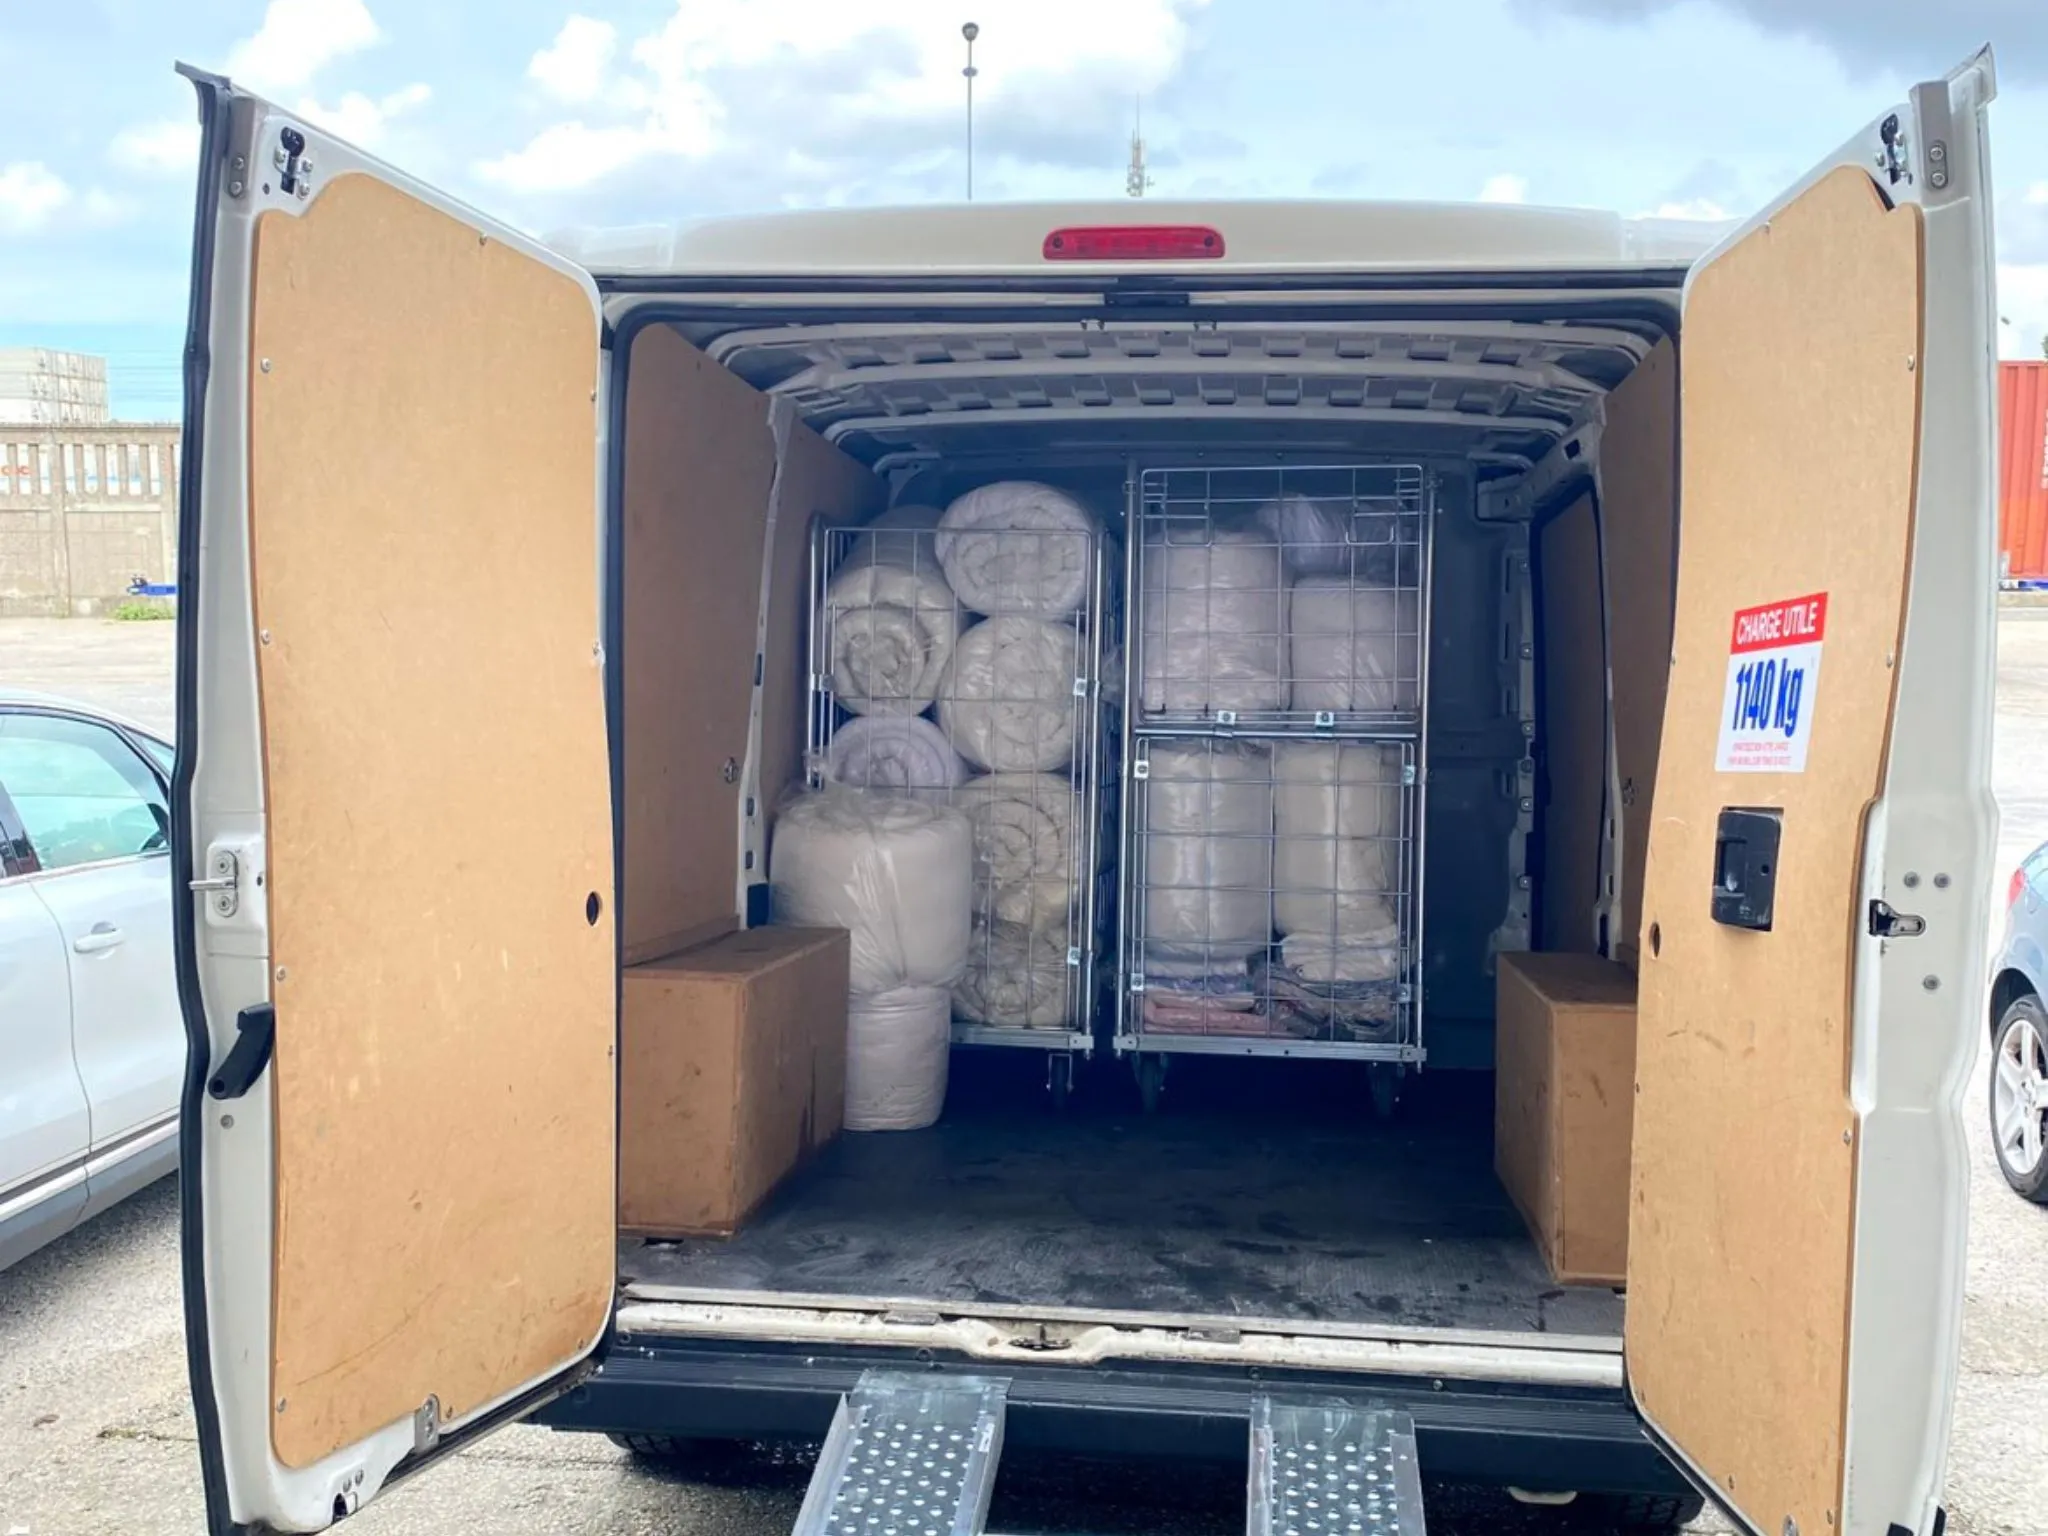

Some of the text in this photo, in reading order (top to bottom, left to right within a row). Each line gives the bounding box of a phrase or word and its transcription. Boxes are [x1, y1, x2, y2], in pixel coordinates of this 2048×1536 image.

[1736, 601, 1819, 645] CHARGE UTILE
[1732, 657, 1804, 738] 1140 kg
